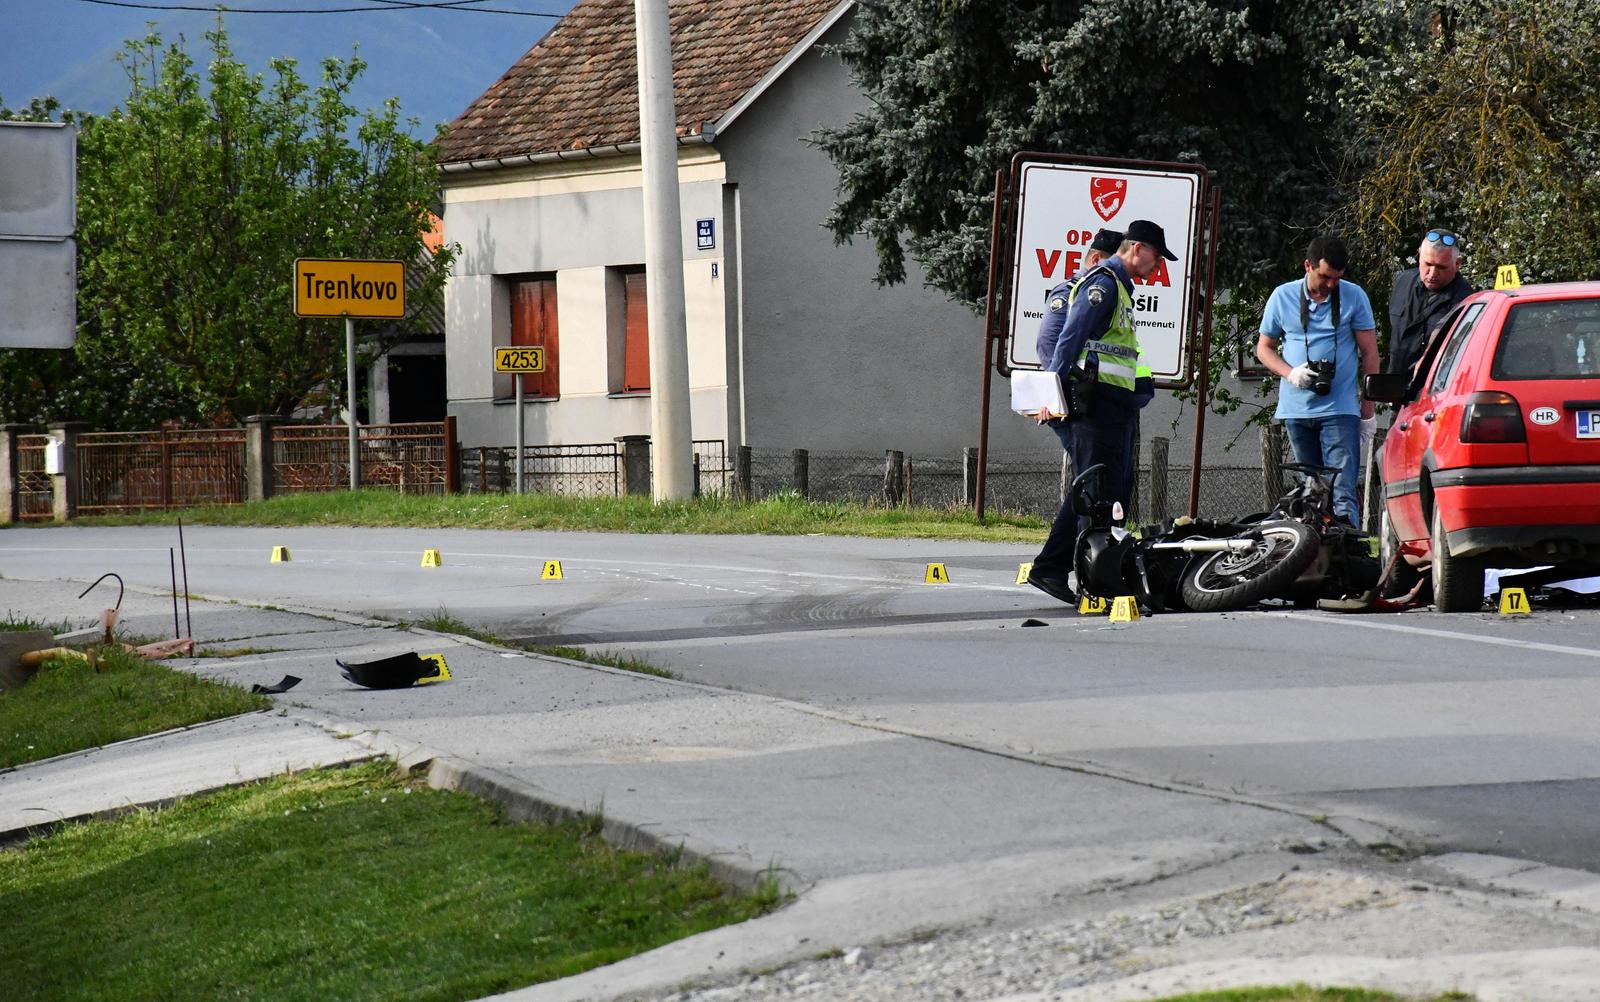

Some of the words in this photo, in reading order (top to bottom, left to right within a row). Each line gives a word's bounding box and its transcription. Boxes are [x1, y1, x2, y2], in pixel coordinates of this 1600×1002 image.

[303, 272, 397, 301] Trenkovo
[1135, 320, 1175, 329] envenuti
[501, 351, 539, 369] 4253
[1536, 411, 1554, 421] HR
